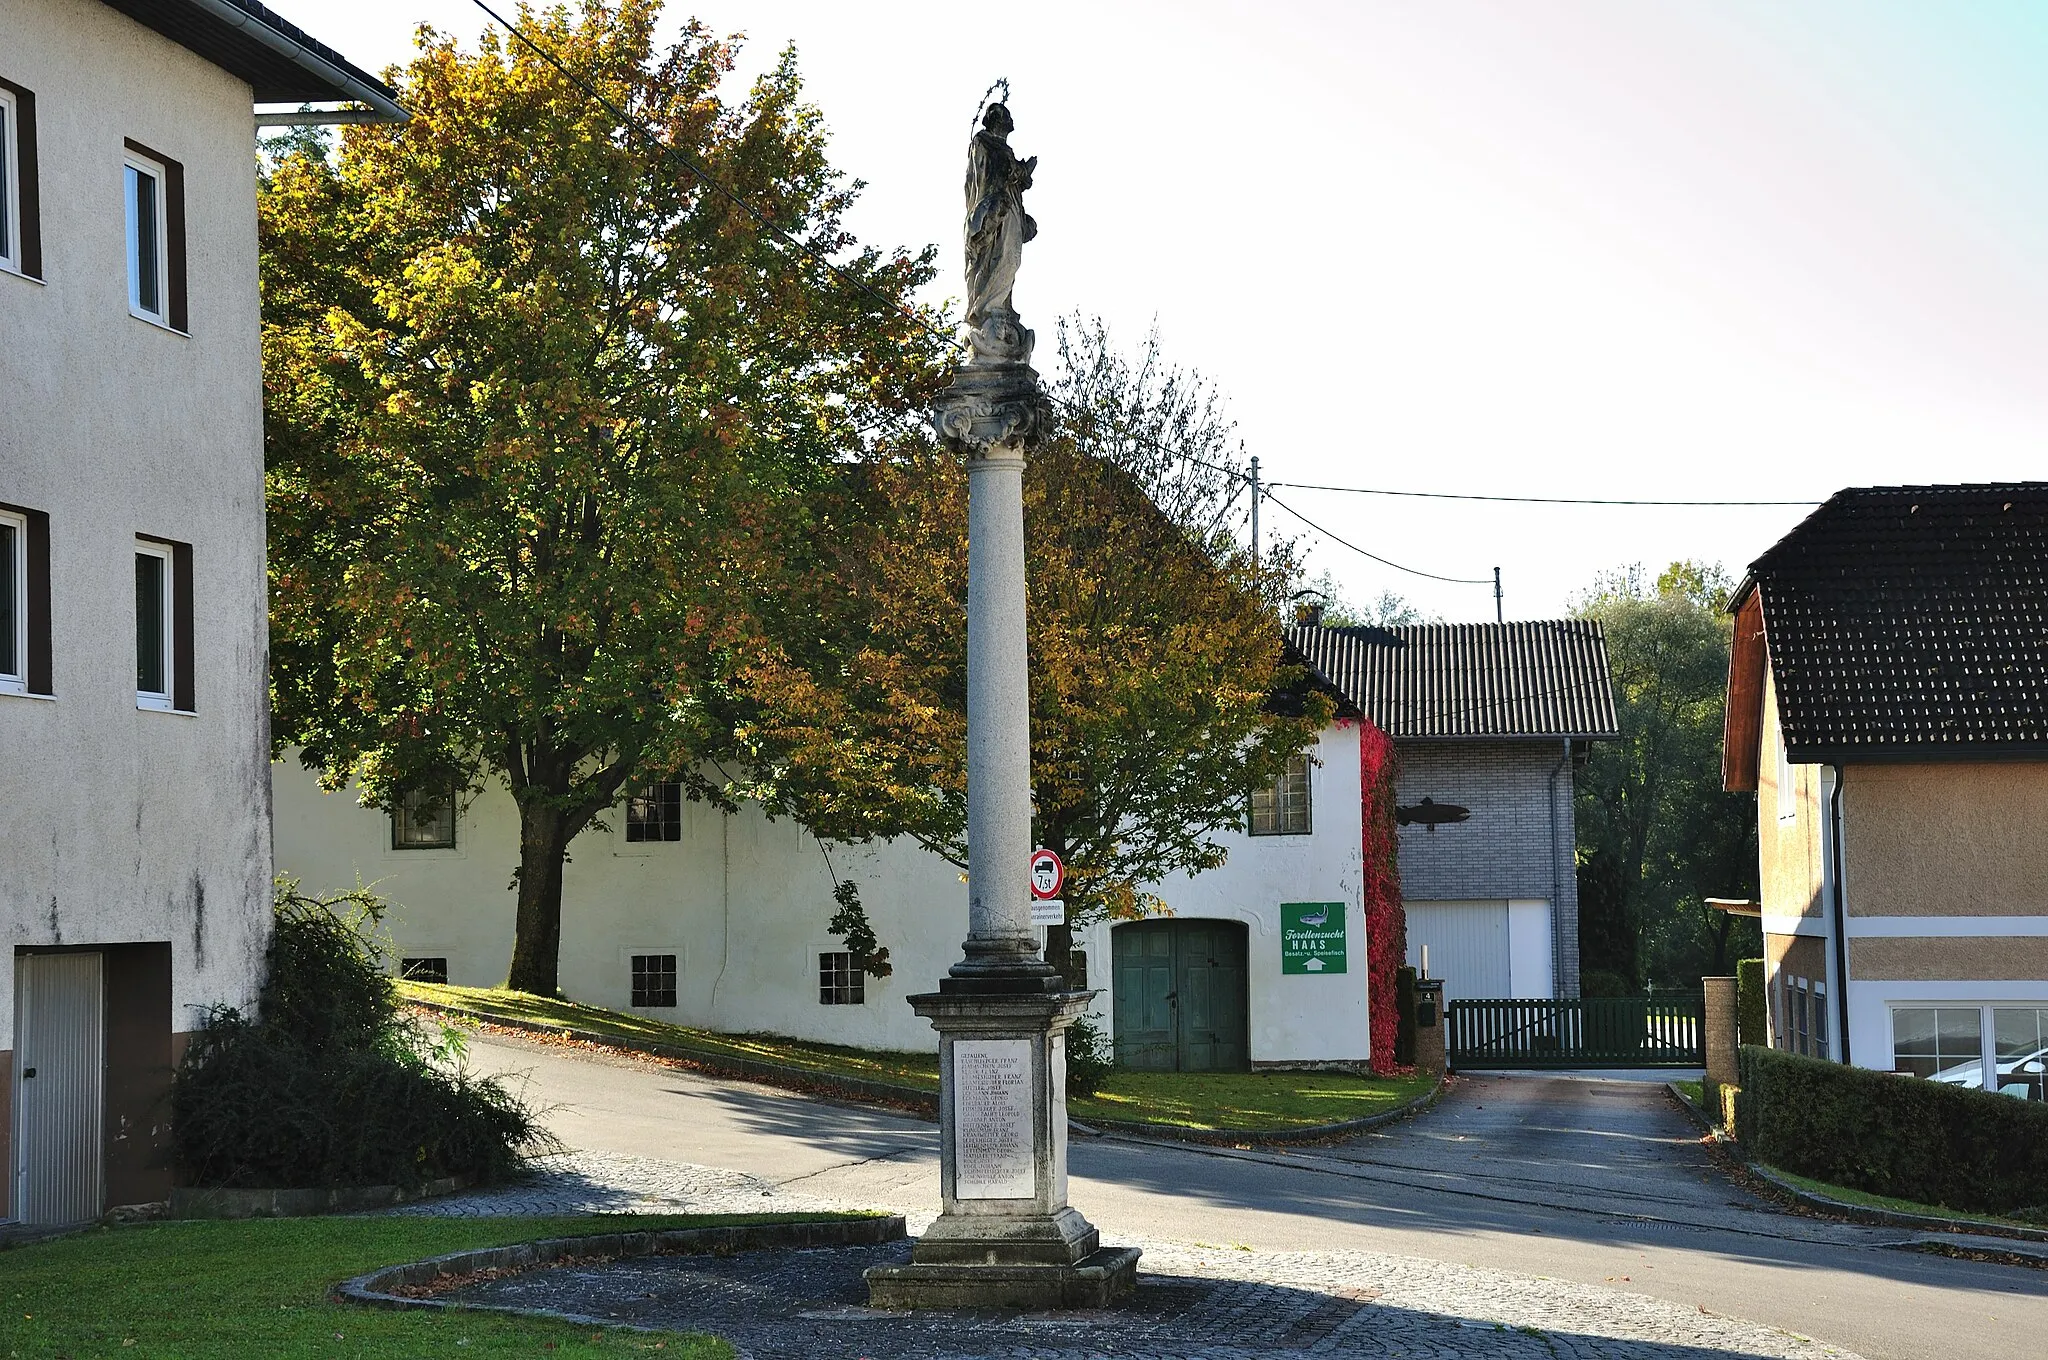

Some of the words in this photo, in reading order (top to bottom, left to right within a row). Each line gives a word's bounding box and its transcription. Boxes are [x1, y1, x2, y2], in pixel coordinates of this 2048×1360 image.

[1038, 875, 1051, 889] 7,5t
[1285, 929, 1344, 940] Forellenzucht
[1292, 940, 1326, 949] HAAS
